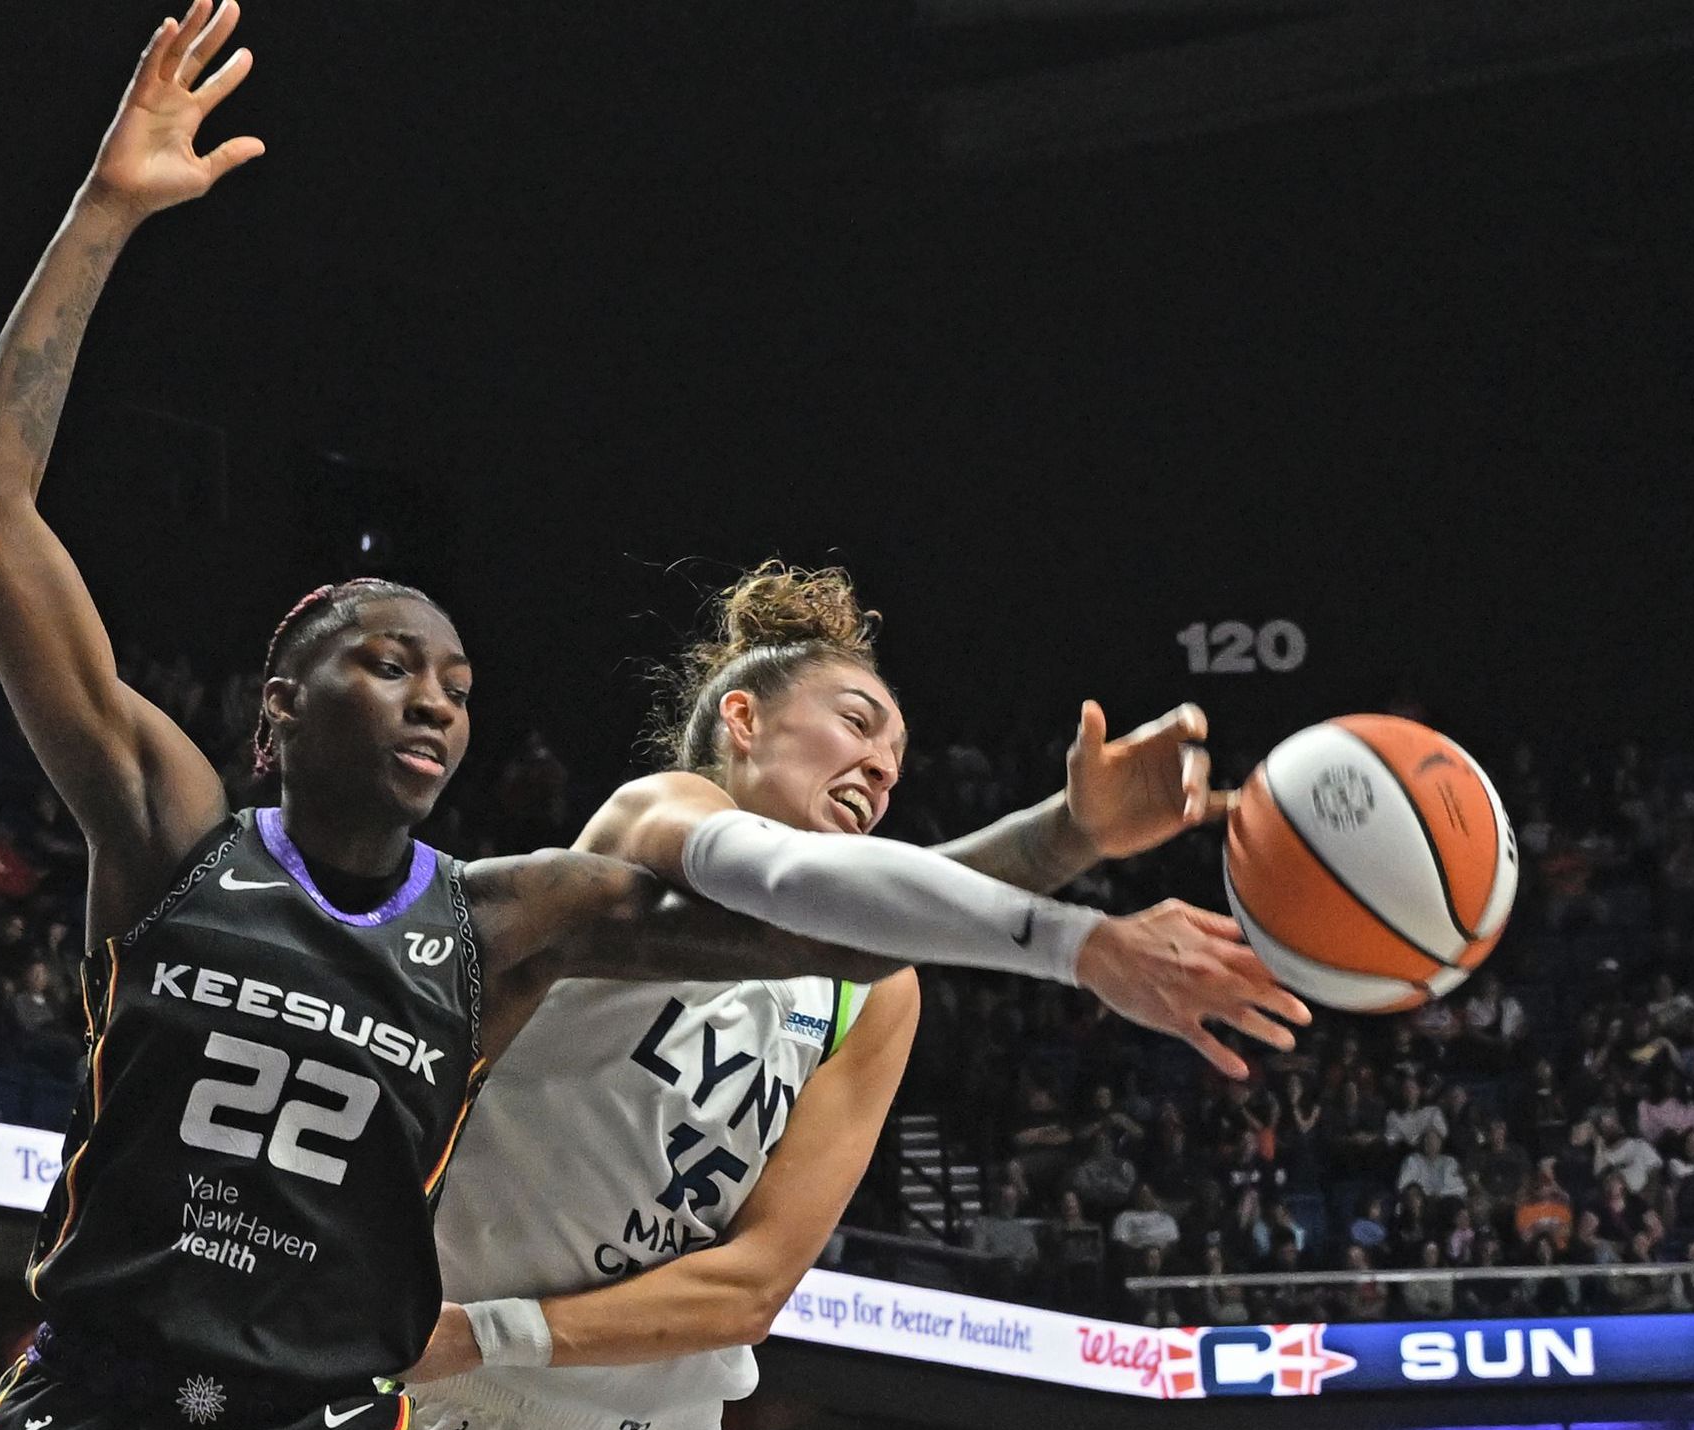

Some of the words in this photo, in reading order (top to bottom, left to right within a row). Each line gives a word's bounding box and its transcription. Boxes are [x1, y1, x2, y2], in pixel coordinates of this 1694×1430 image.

[1176, 619, 1306, 673] 120
[151, 962, 445, 1086] KEESUSK
[630, 997, 797, 1152] LYN
[179, 1031, 380, 1186] 22
[188, 1173, 239, 1204] Yale
[182, 1202, 317, 1263] NewHaven
[819, 1295, 847, 1328] up
[854, 1293, 883, 1326] for
[892, 1300, 953, 1338] better
[959, 1312, 1033, 1352] health!
[1400, 1327, 1594, 1381] SUN
